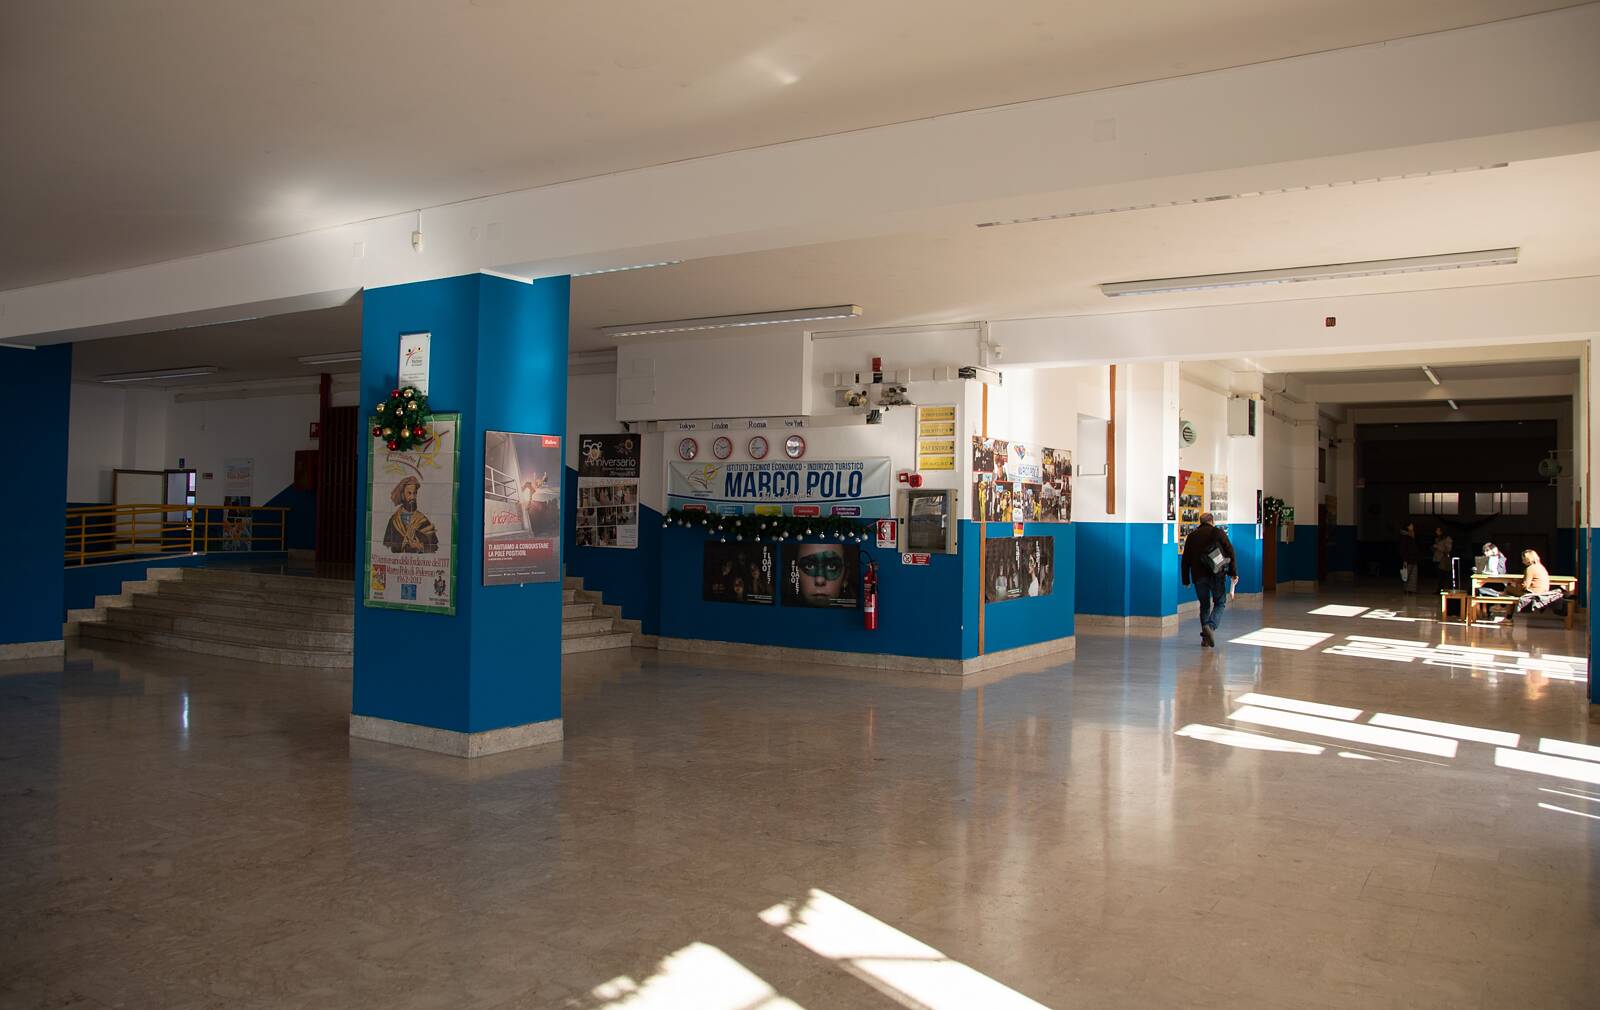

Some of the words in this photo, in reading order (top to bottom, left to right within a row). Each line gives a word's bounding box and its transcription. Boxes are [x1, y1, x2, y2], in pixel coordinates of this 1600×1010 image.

[584, 456, 636, 467] Anniversario
[726, 463, 749, 471] ISTITUTO
[749, 463, 771, 471] TECNICO
[771, 462, 803, 471] ECONOMICO
[807, 462, 834, 471] INDIRIZZO
[835, 462, 864, 470] TURISTICO
[724, 471, 799, 498] MARCO
[806, 470, 863, 497] POLO
